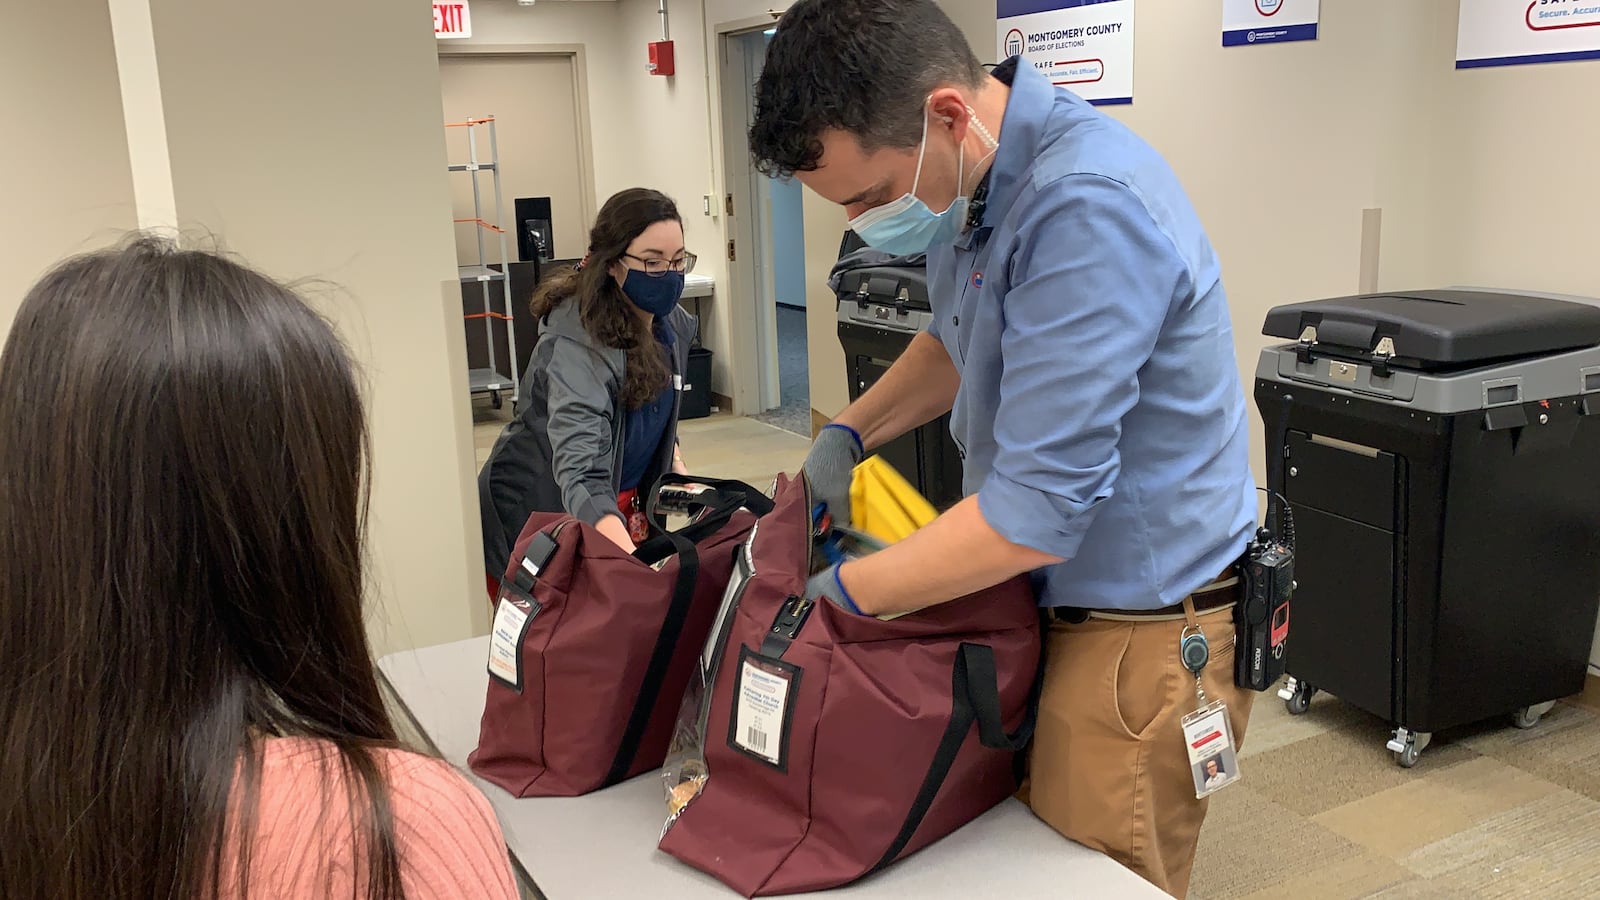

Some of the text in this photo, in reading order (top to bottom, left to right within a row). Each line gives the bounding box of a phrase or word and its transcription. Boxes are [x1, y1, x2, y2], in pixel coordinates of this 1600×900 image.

[1028, 22, 1123, 43] MONTGOMERY COUNTY
[1028, 40, 1085, 53] BOARD OF ELECTIONS
